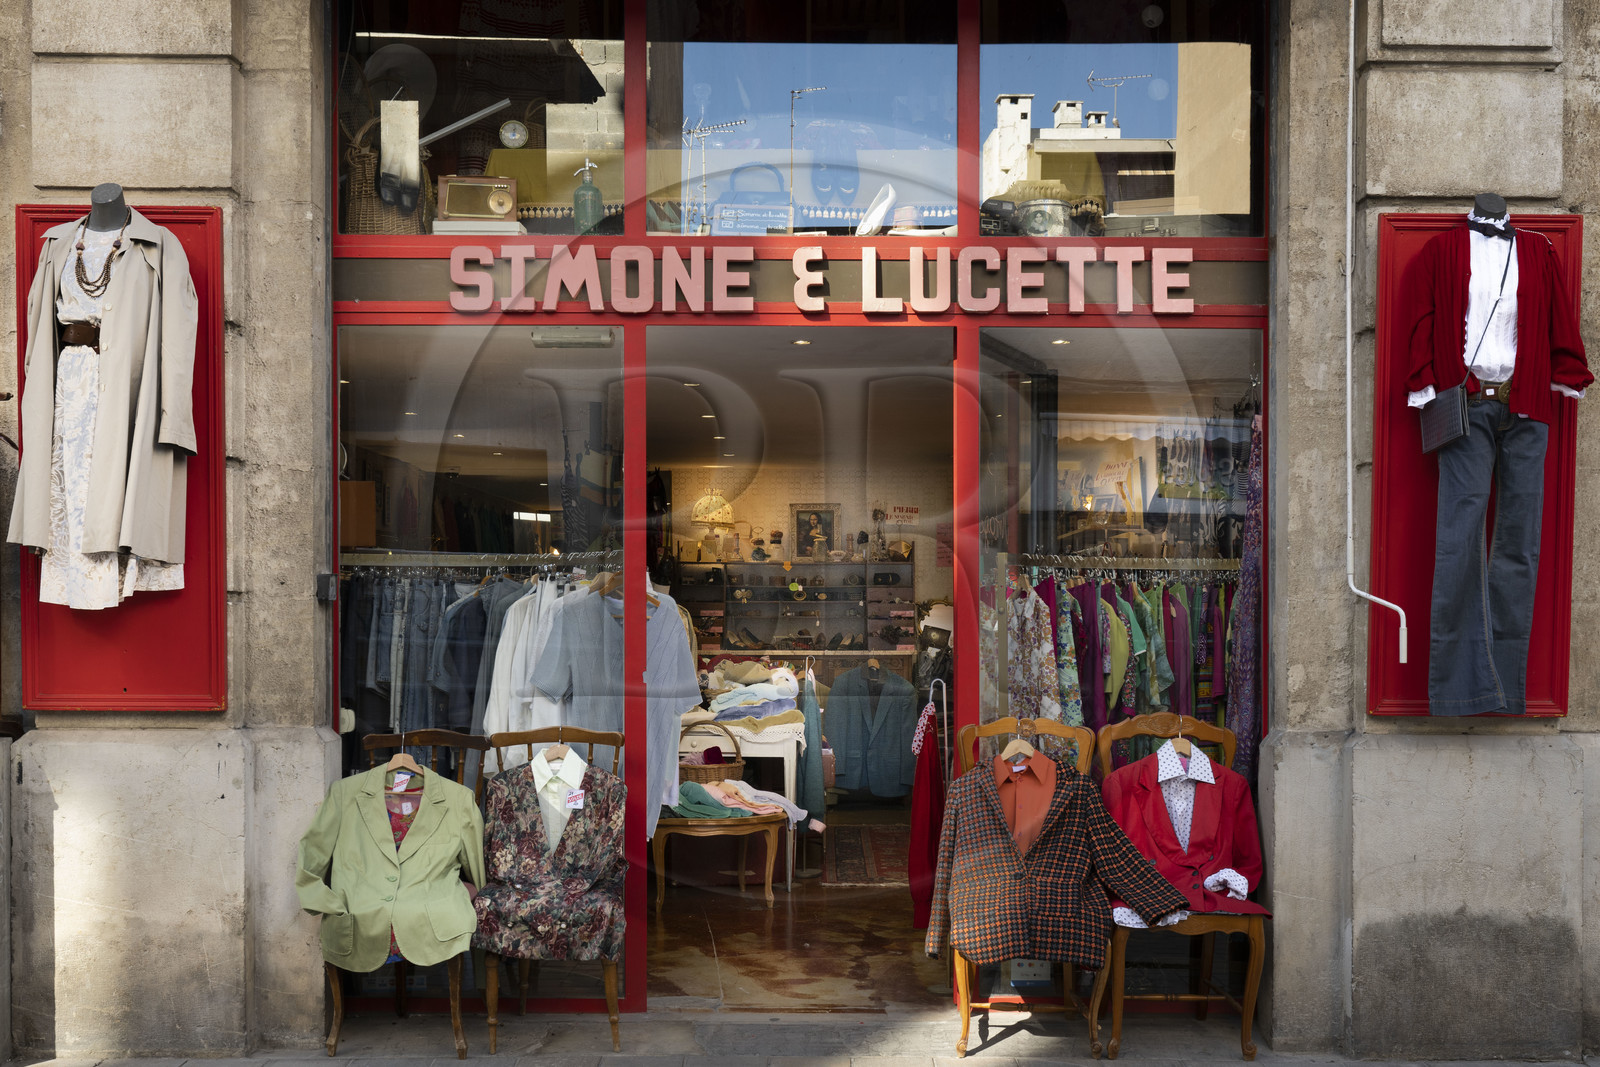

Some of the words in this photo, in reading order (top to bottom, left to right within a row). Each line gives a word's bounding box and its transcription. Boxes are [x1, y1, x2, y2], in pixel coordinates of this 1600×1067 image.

[450, 244, 754, 313] SIMONE
[792, 245, 825, 312] &
[861, 245, 1194, 314] LUCETTE
